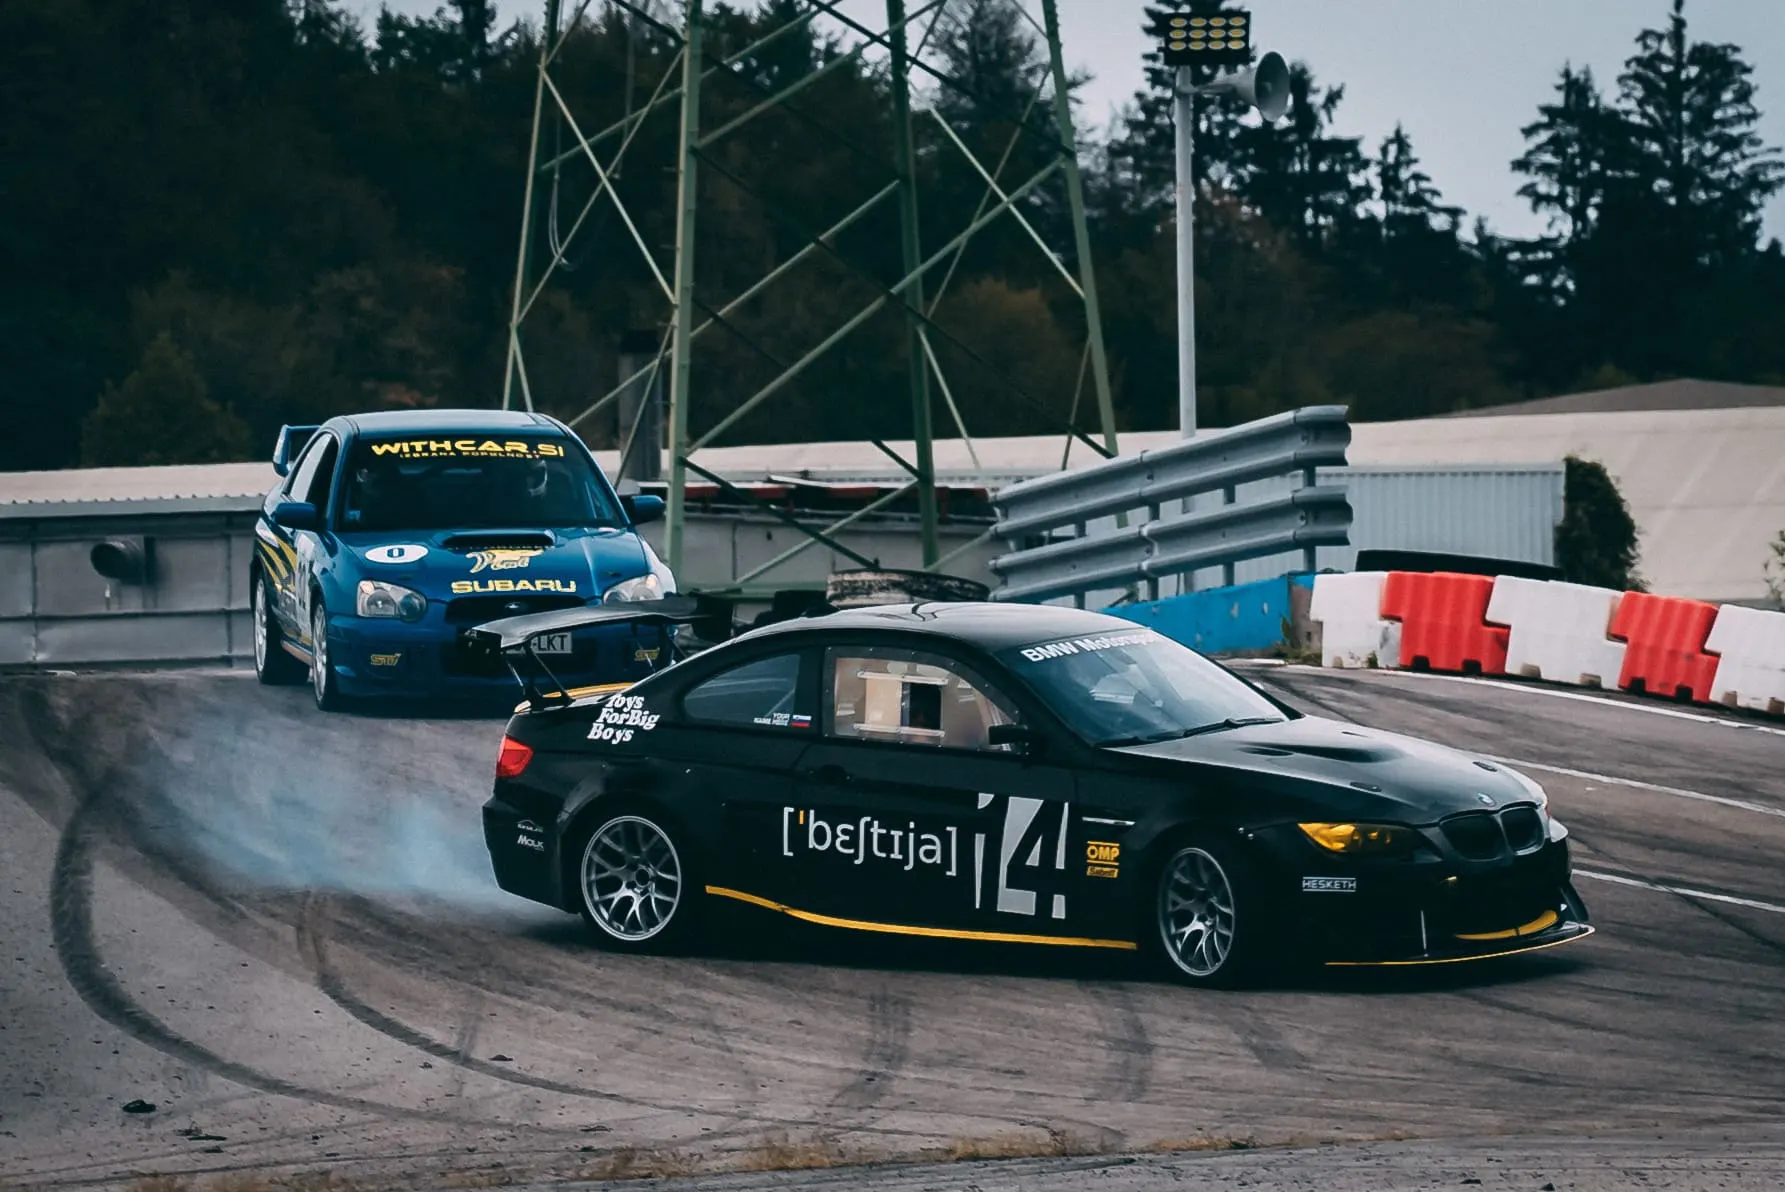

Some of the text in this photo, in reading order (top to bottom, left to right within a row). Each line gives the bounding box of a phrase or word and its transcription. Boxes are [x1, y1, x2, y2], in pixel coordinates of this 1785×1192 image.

[372, 440, 564, 457] WITHCAR.SI
[451, 579, 577, 594] SUBARU
[1020, 642, 1079, 662] BMW
[605, 693, 645, 712] Toys
[587, 722, 634, 745] Boys
[1087, 845, 1120, 861] OMP
[1302, 879, 1357, 889] HESKETH
